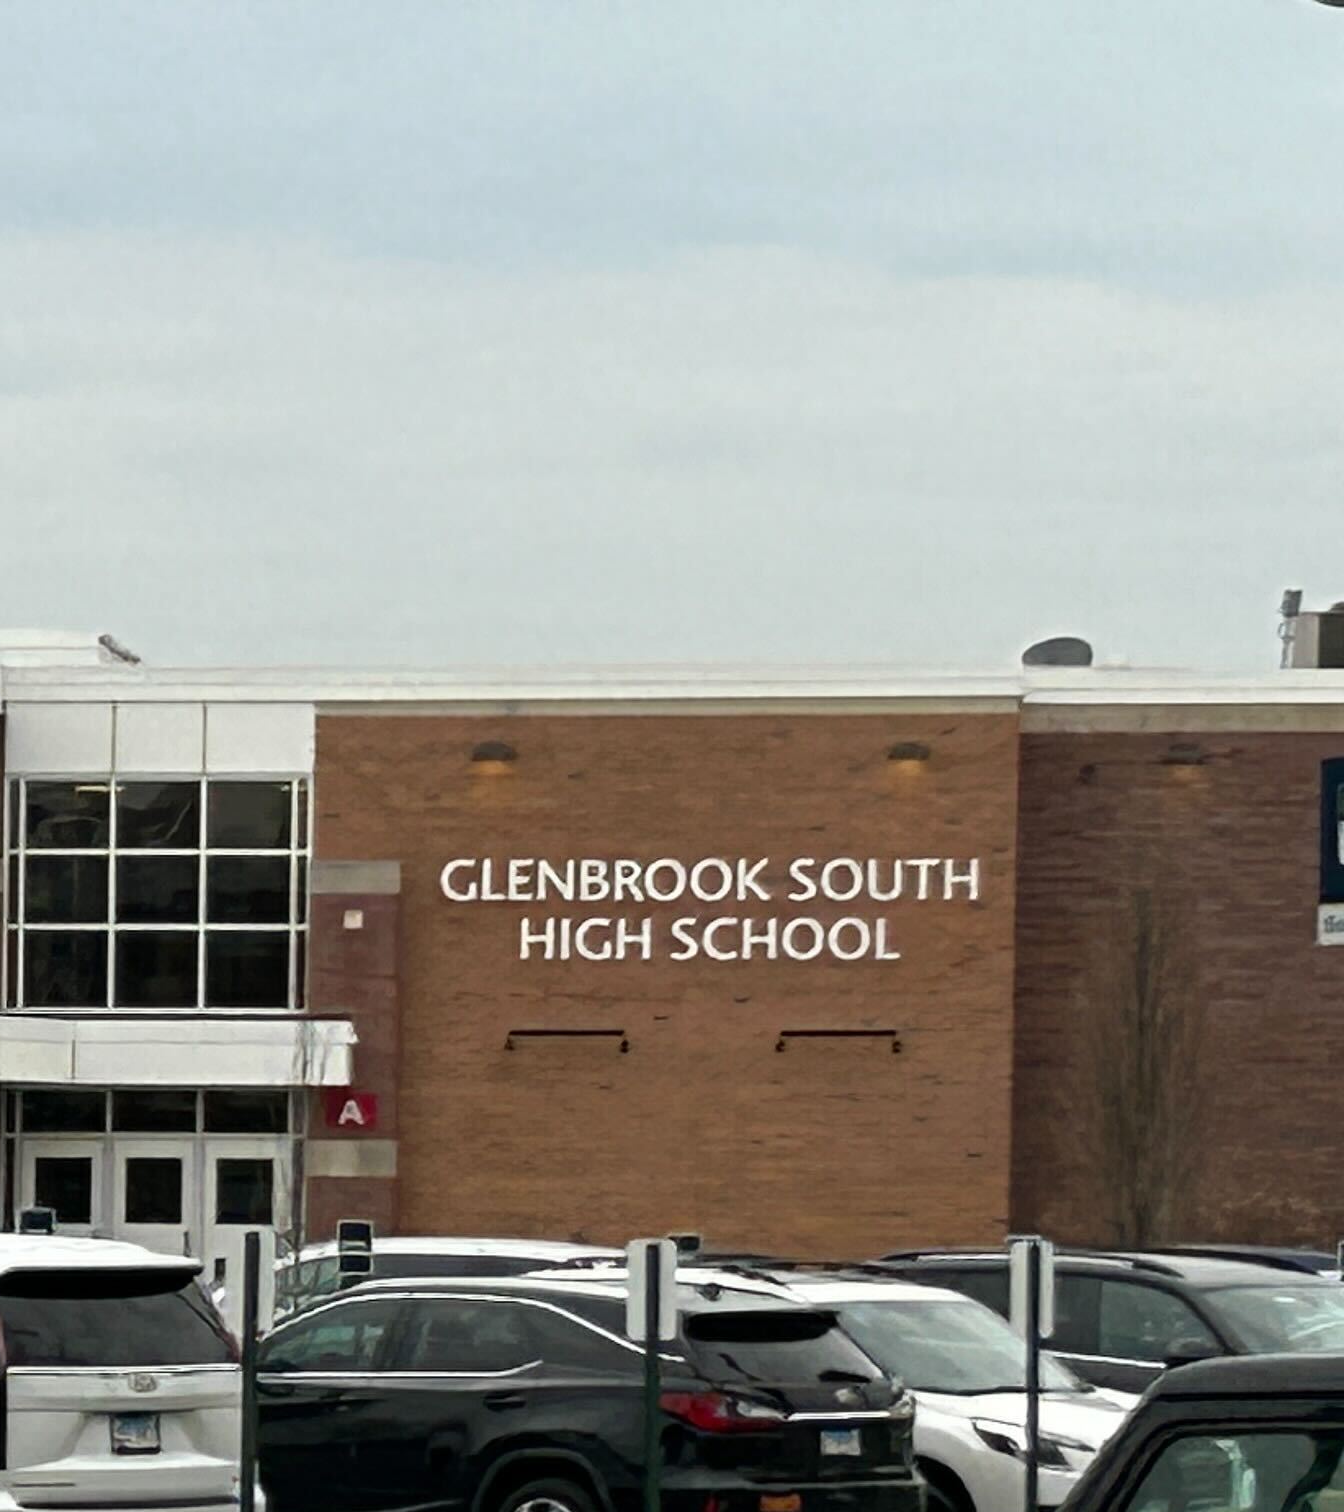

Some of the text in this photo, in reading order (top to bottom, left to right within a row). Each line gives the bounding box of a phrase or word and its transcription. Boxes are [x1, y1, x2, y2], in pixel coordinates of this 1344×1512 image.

[440, 857, 980, 902] GLENBROOK SOUTH
[519, 916, 901, 961] HIGH SCHOOL
[338, 1099, 365, 1125] A
